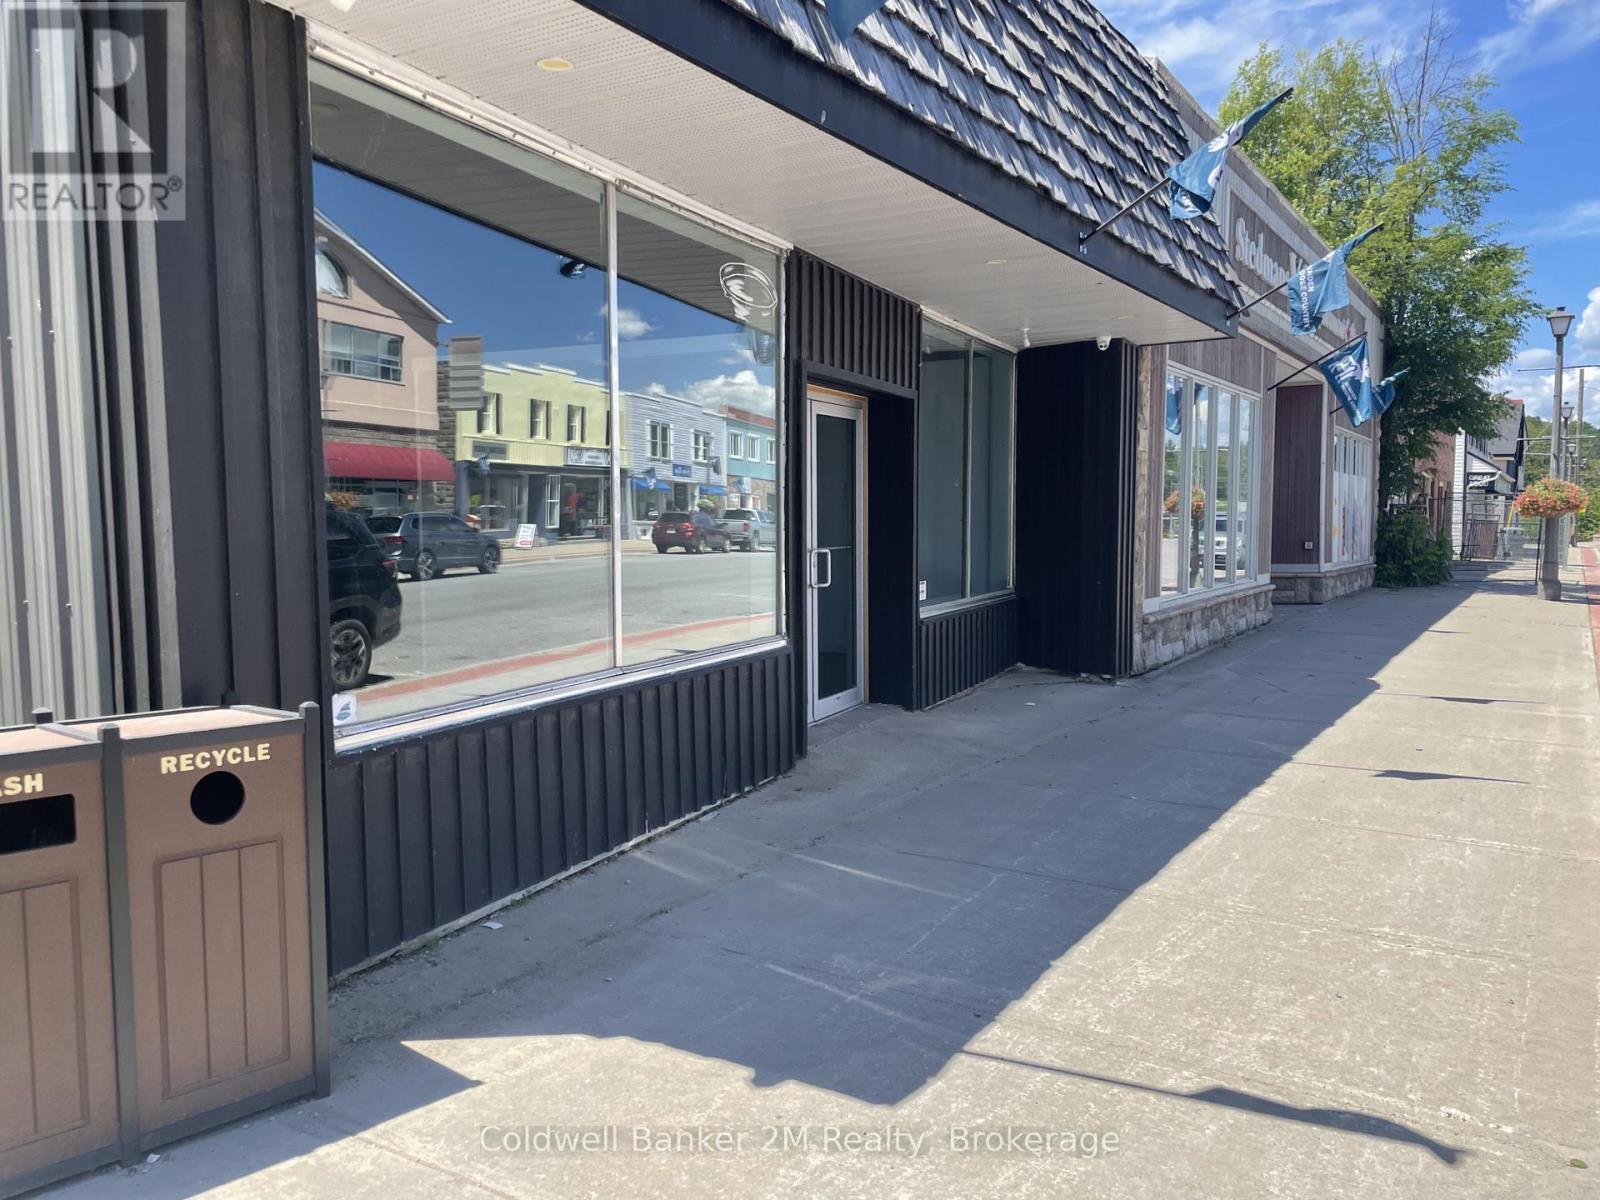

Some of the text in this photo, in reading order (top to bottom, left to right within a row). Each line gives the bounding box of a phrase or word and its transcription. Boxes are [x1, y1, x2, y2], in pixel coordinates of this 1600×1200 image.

[1300, 291, 1310, 328] COUNTRY
[160, 743, 271, 774] RECYCLE
[0, 773, 44, 796] SH
